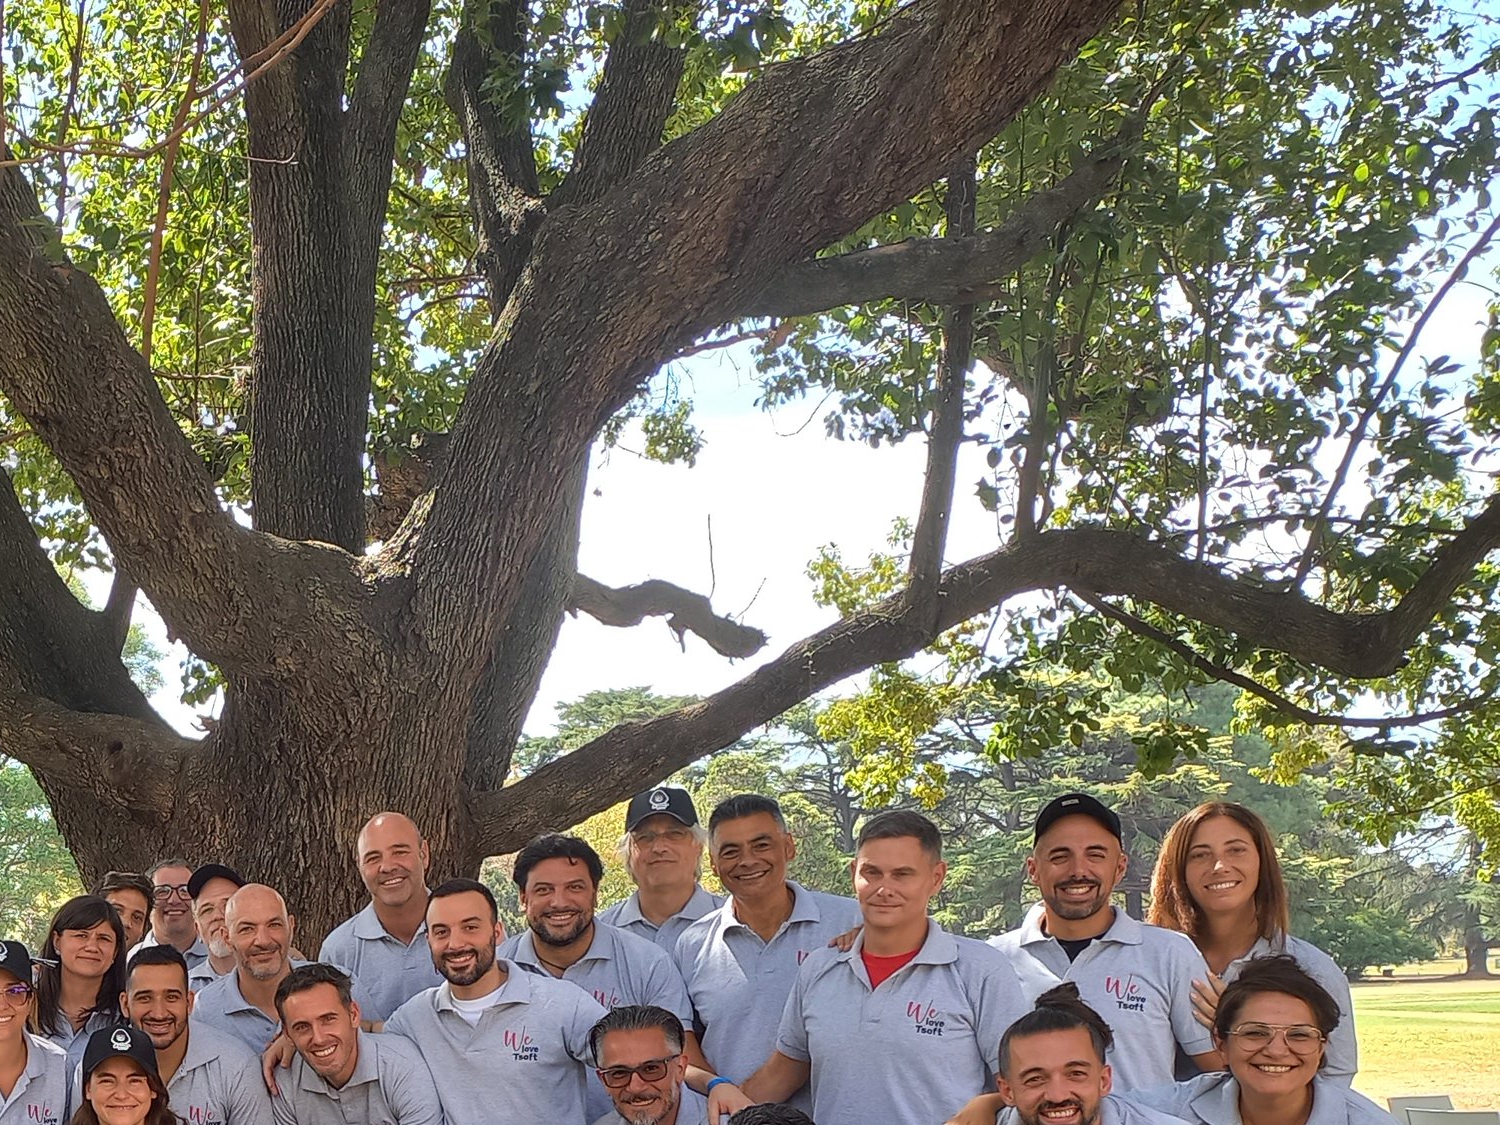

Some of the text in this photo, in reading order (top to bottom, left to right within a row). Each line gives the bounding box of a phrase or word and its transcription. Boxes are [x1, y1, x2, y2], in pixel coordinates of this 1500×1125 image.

[1105, 973, 1140, 1000] We
[1126, 993, 1146, 1003] love
[906, 999, 940, 1025] We
[1116, 1000, 1144, 1012] Tsoft
[925, 1018, 945, 1028] love
[915, 1025, 943, 1037] Tsoft
[504, 1025, 533, 1052] We
[521, 1045, 539, 1053] love
[513, 1053, 538, 1061] Tsoft
[28, 1101, 52, 1123] We
[189, 1102, 215, 1125] We
